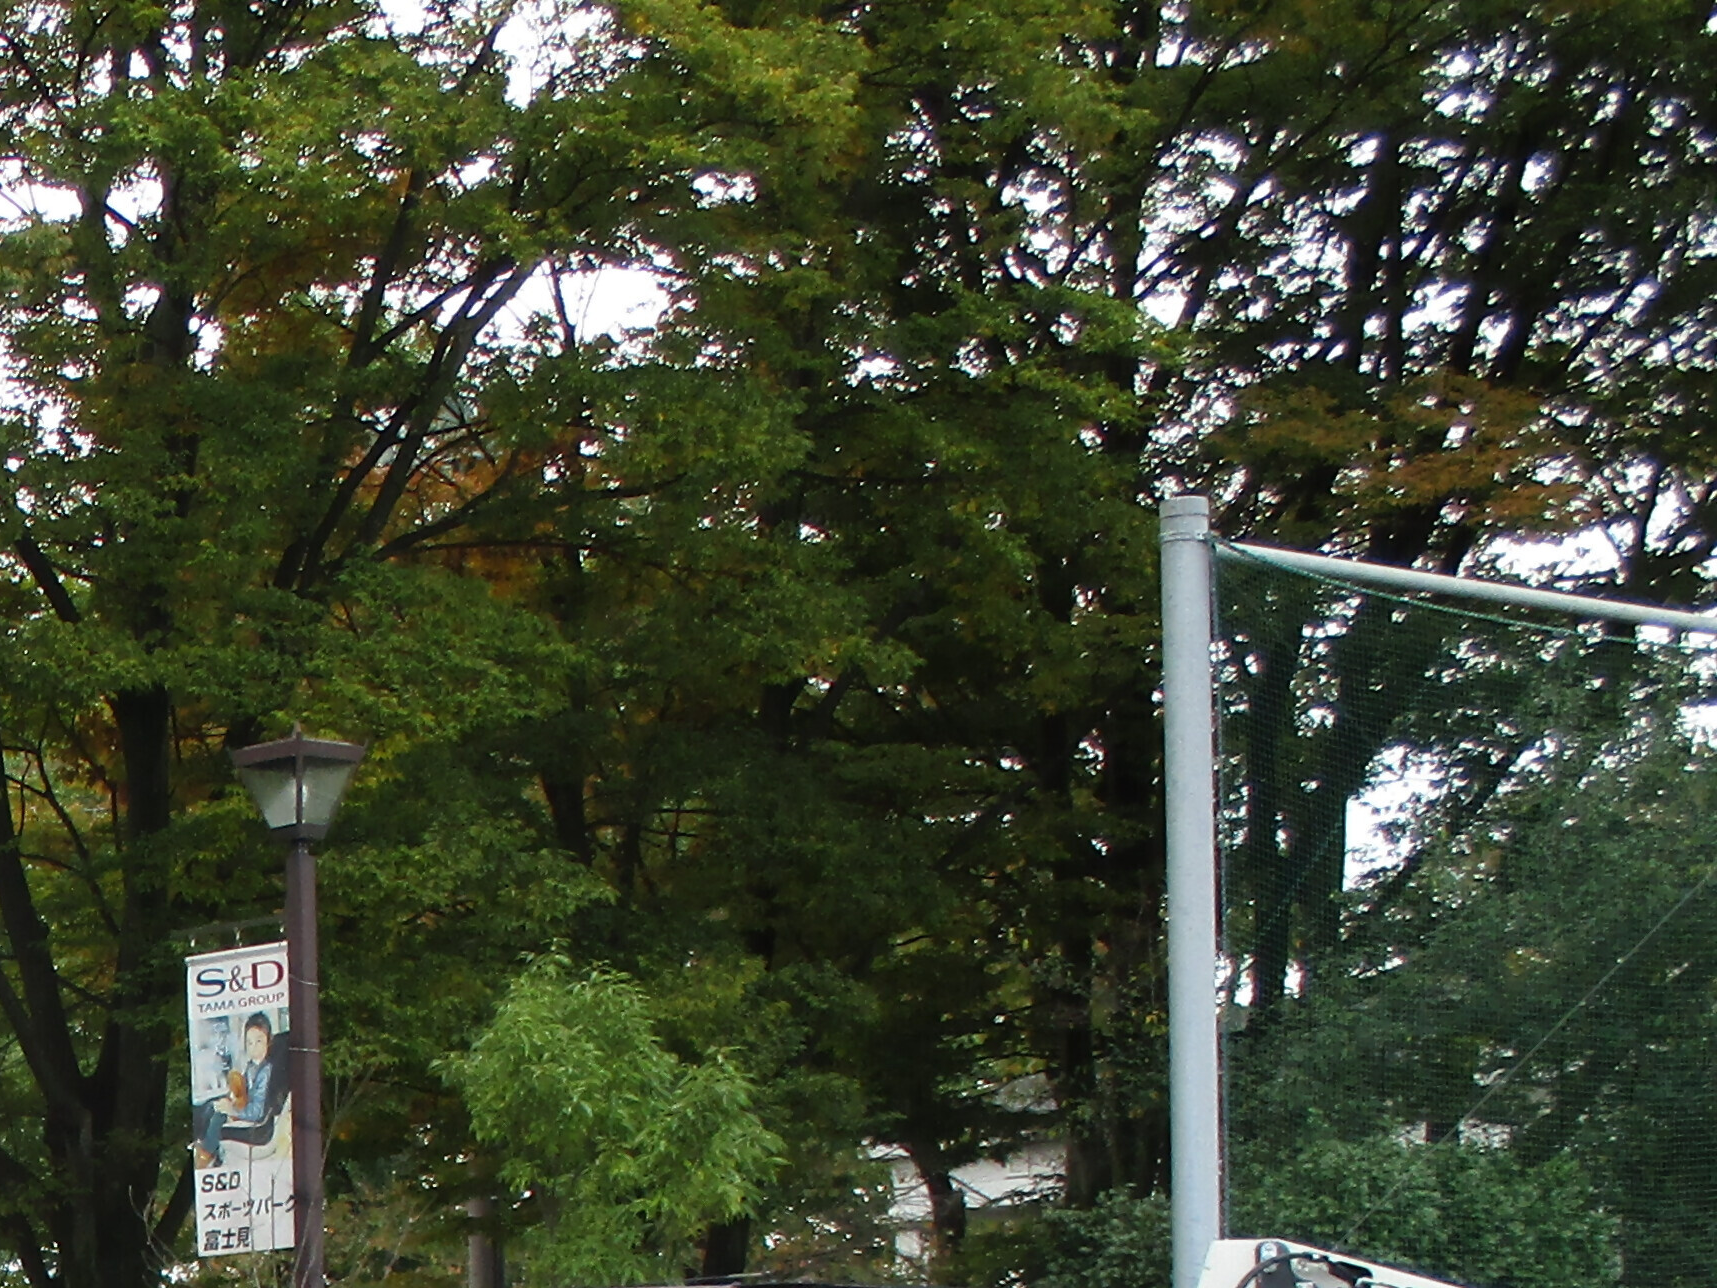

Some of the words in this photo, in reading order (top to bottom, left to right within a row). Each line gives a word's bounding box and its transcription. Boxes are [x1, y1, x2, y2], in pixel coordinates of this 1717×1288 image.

[196, 960, 284, 998] S&D
[198, 999, 235, 1014] TAMA
[238, 991, 285, 1008] GROUP
[201, 1171, 241, 1193] S&D
[203, 1195, 295, 1222] スポーツパーク
[203, 1226, 251, 1251] 富士見
